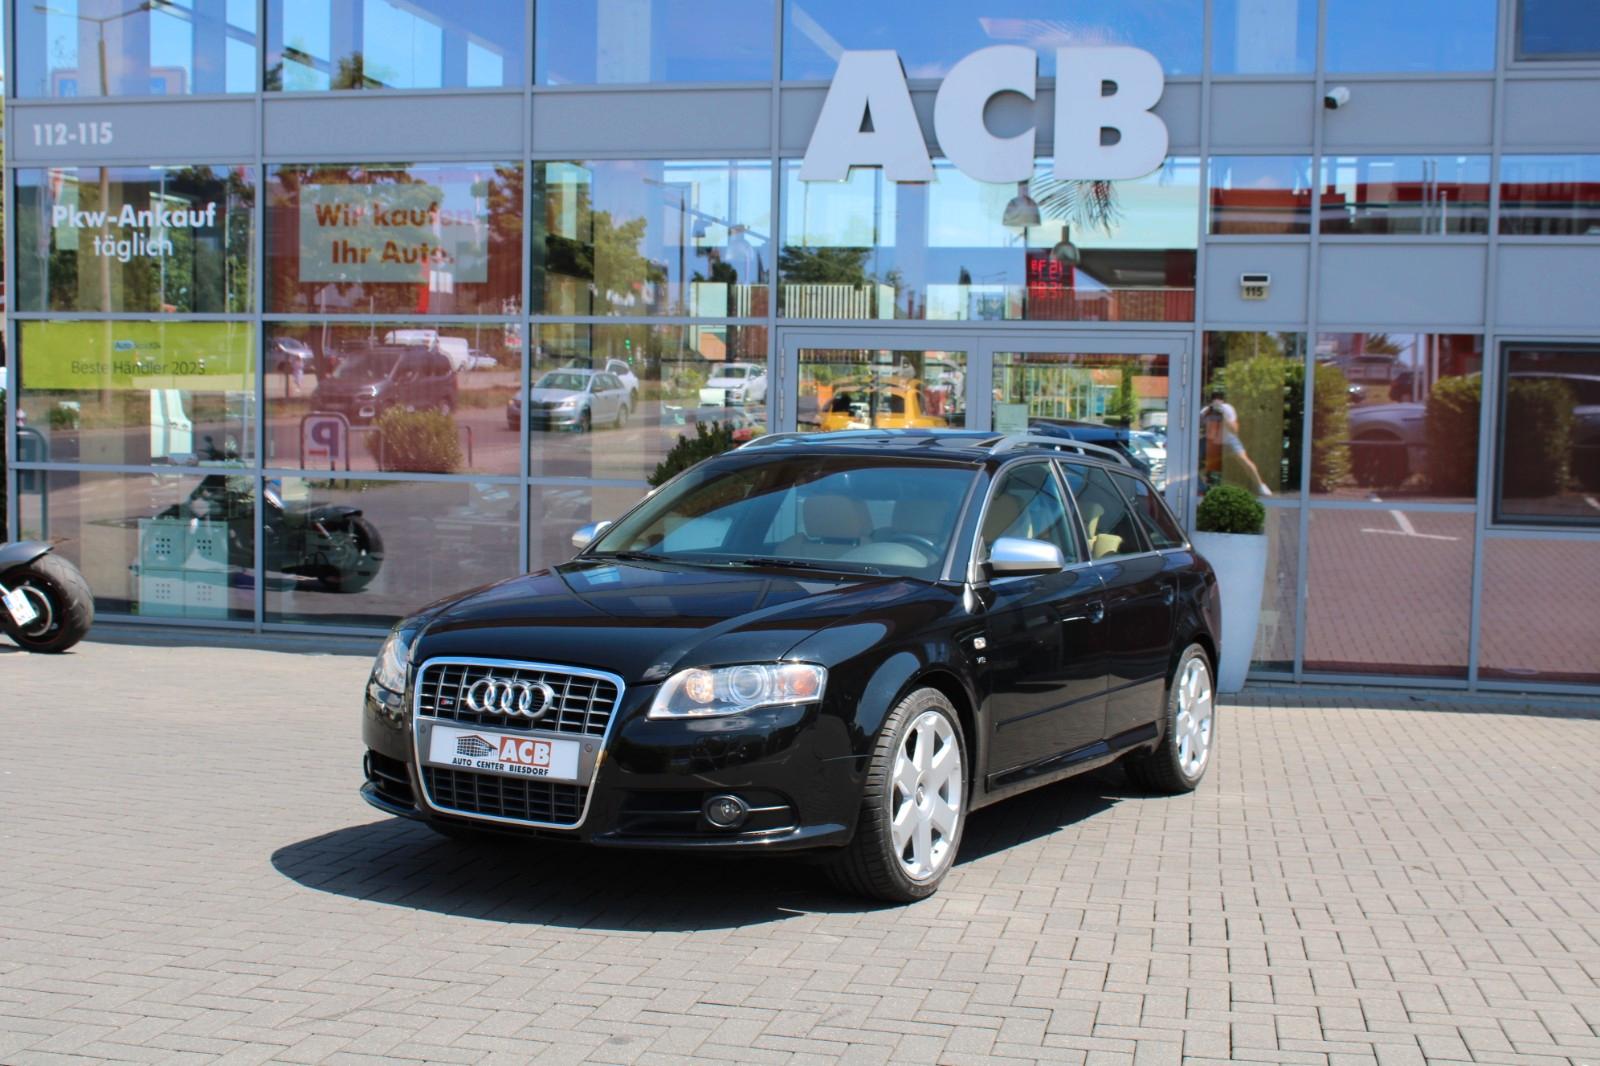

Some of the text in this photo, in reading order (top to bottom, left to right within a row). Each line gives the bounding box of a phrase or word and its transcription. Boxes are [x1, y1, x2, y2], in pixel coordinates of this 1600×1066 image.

[798, 44, 1169, 184] ACB
[33, 122, 112, 146] 112-115
[52, 202, 217, 228] Pkw-Ankauf
[315, 203, 365, 227] Wir
[94, 232, 173, 263] täglich
[332, 240, 372, 264] Ihr
[1245, 286, 1263, 297] 115
[71, 361, 109, 375] Beste
[113, 360, 168, 375] Händler
[500, 738, 550, 766] ACB
[452, 757, 549, 777] AUTO CENTER BIESDORF
